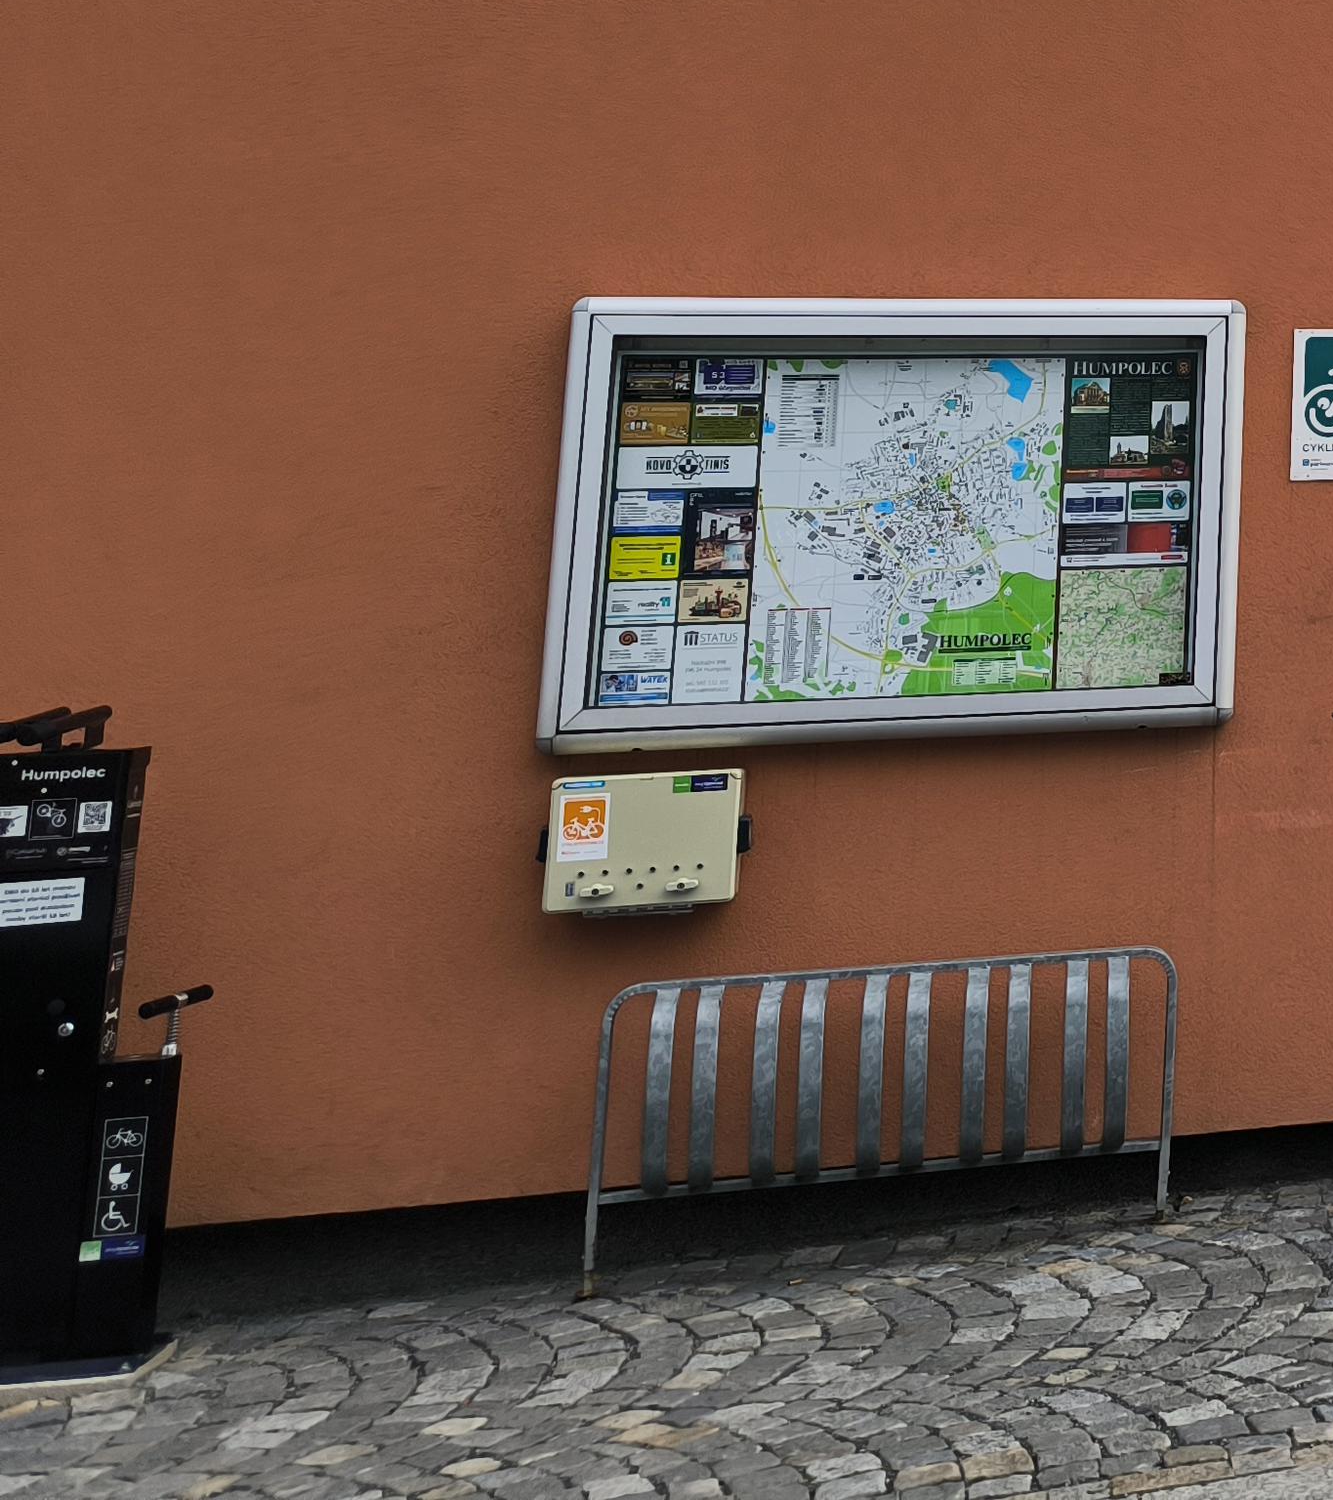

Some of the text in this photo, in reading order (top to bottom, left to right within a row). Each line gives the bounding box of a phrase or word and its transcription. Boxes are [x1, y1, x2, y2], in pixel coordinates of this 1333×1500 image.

[1073, 361, 1173, 376] HUMPOLEC
[701, 632, 738, 643] STATUS
[939, 633, 1032, 649] HUMPOLEC
[21, 766, 106, 783] Humpolec
